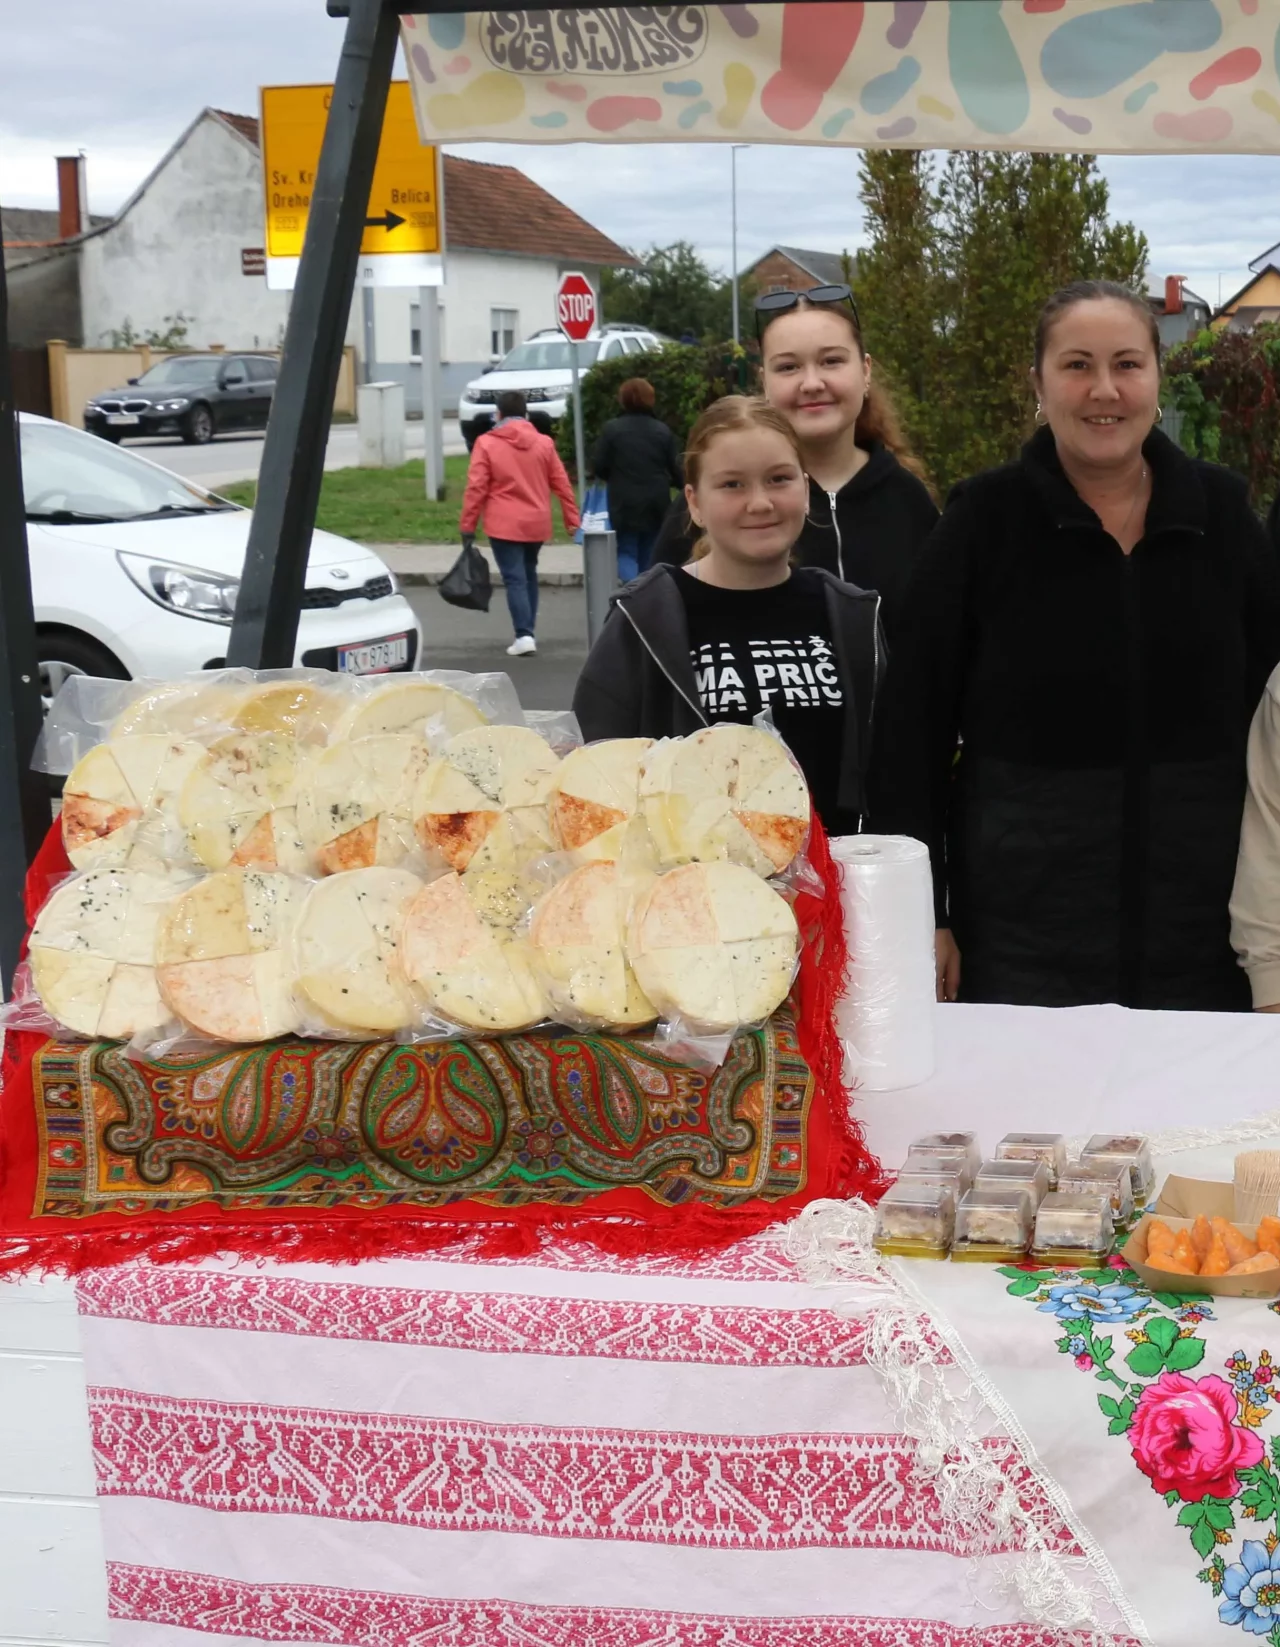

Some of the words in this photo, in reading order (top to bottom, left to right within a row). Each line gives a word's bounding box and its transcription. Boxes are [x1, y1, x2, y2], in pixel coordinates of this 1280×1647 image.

[272, 170, 294, 185] Sv.
[272, 192, 310, 208] Oreho
[391, 188, 430, 204] Belica
[559, 293, 593, 322] STOP
